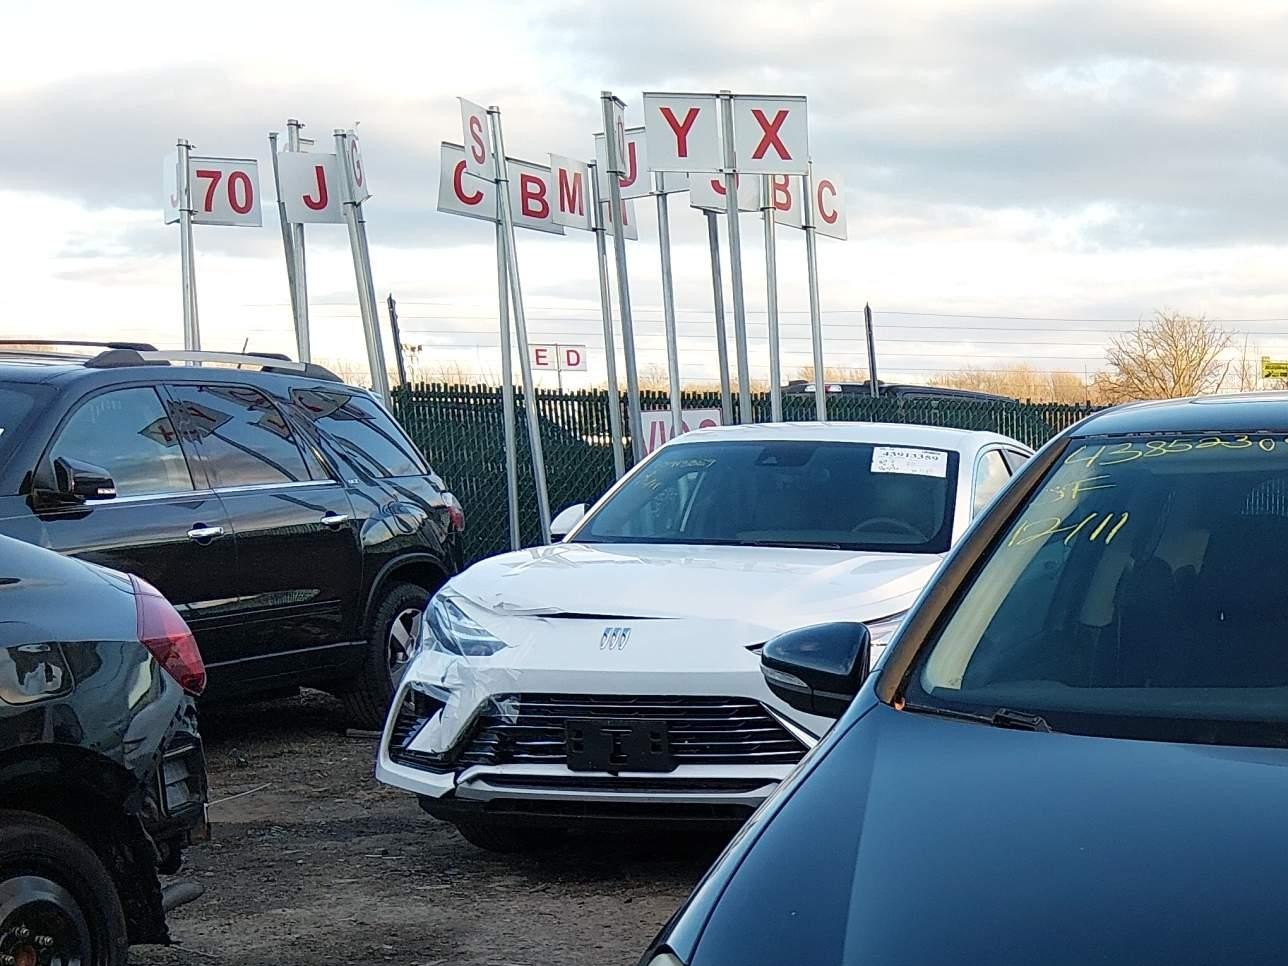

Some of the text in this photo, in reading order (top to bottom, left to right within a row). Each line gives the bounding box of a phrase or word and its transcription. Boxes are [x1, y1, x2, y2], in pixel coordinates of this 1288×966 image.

[469, 115, 486, 165] S
[659, 107, 701, 158] Y
[751, 109, 793, 161] X
[196, 169, 254, 215] 70
[302, 165, 329, 211] J
[453, 159, 485, 206] C
[520, 173, 550, 219] B
[558, 167, 585, 217] M
[817, 179, 839, 225] C
[535, 348, 549, 366] E
[566, 349, 581, 367] D
